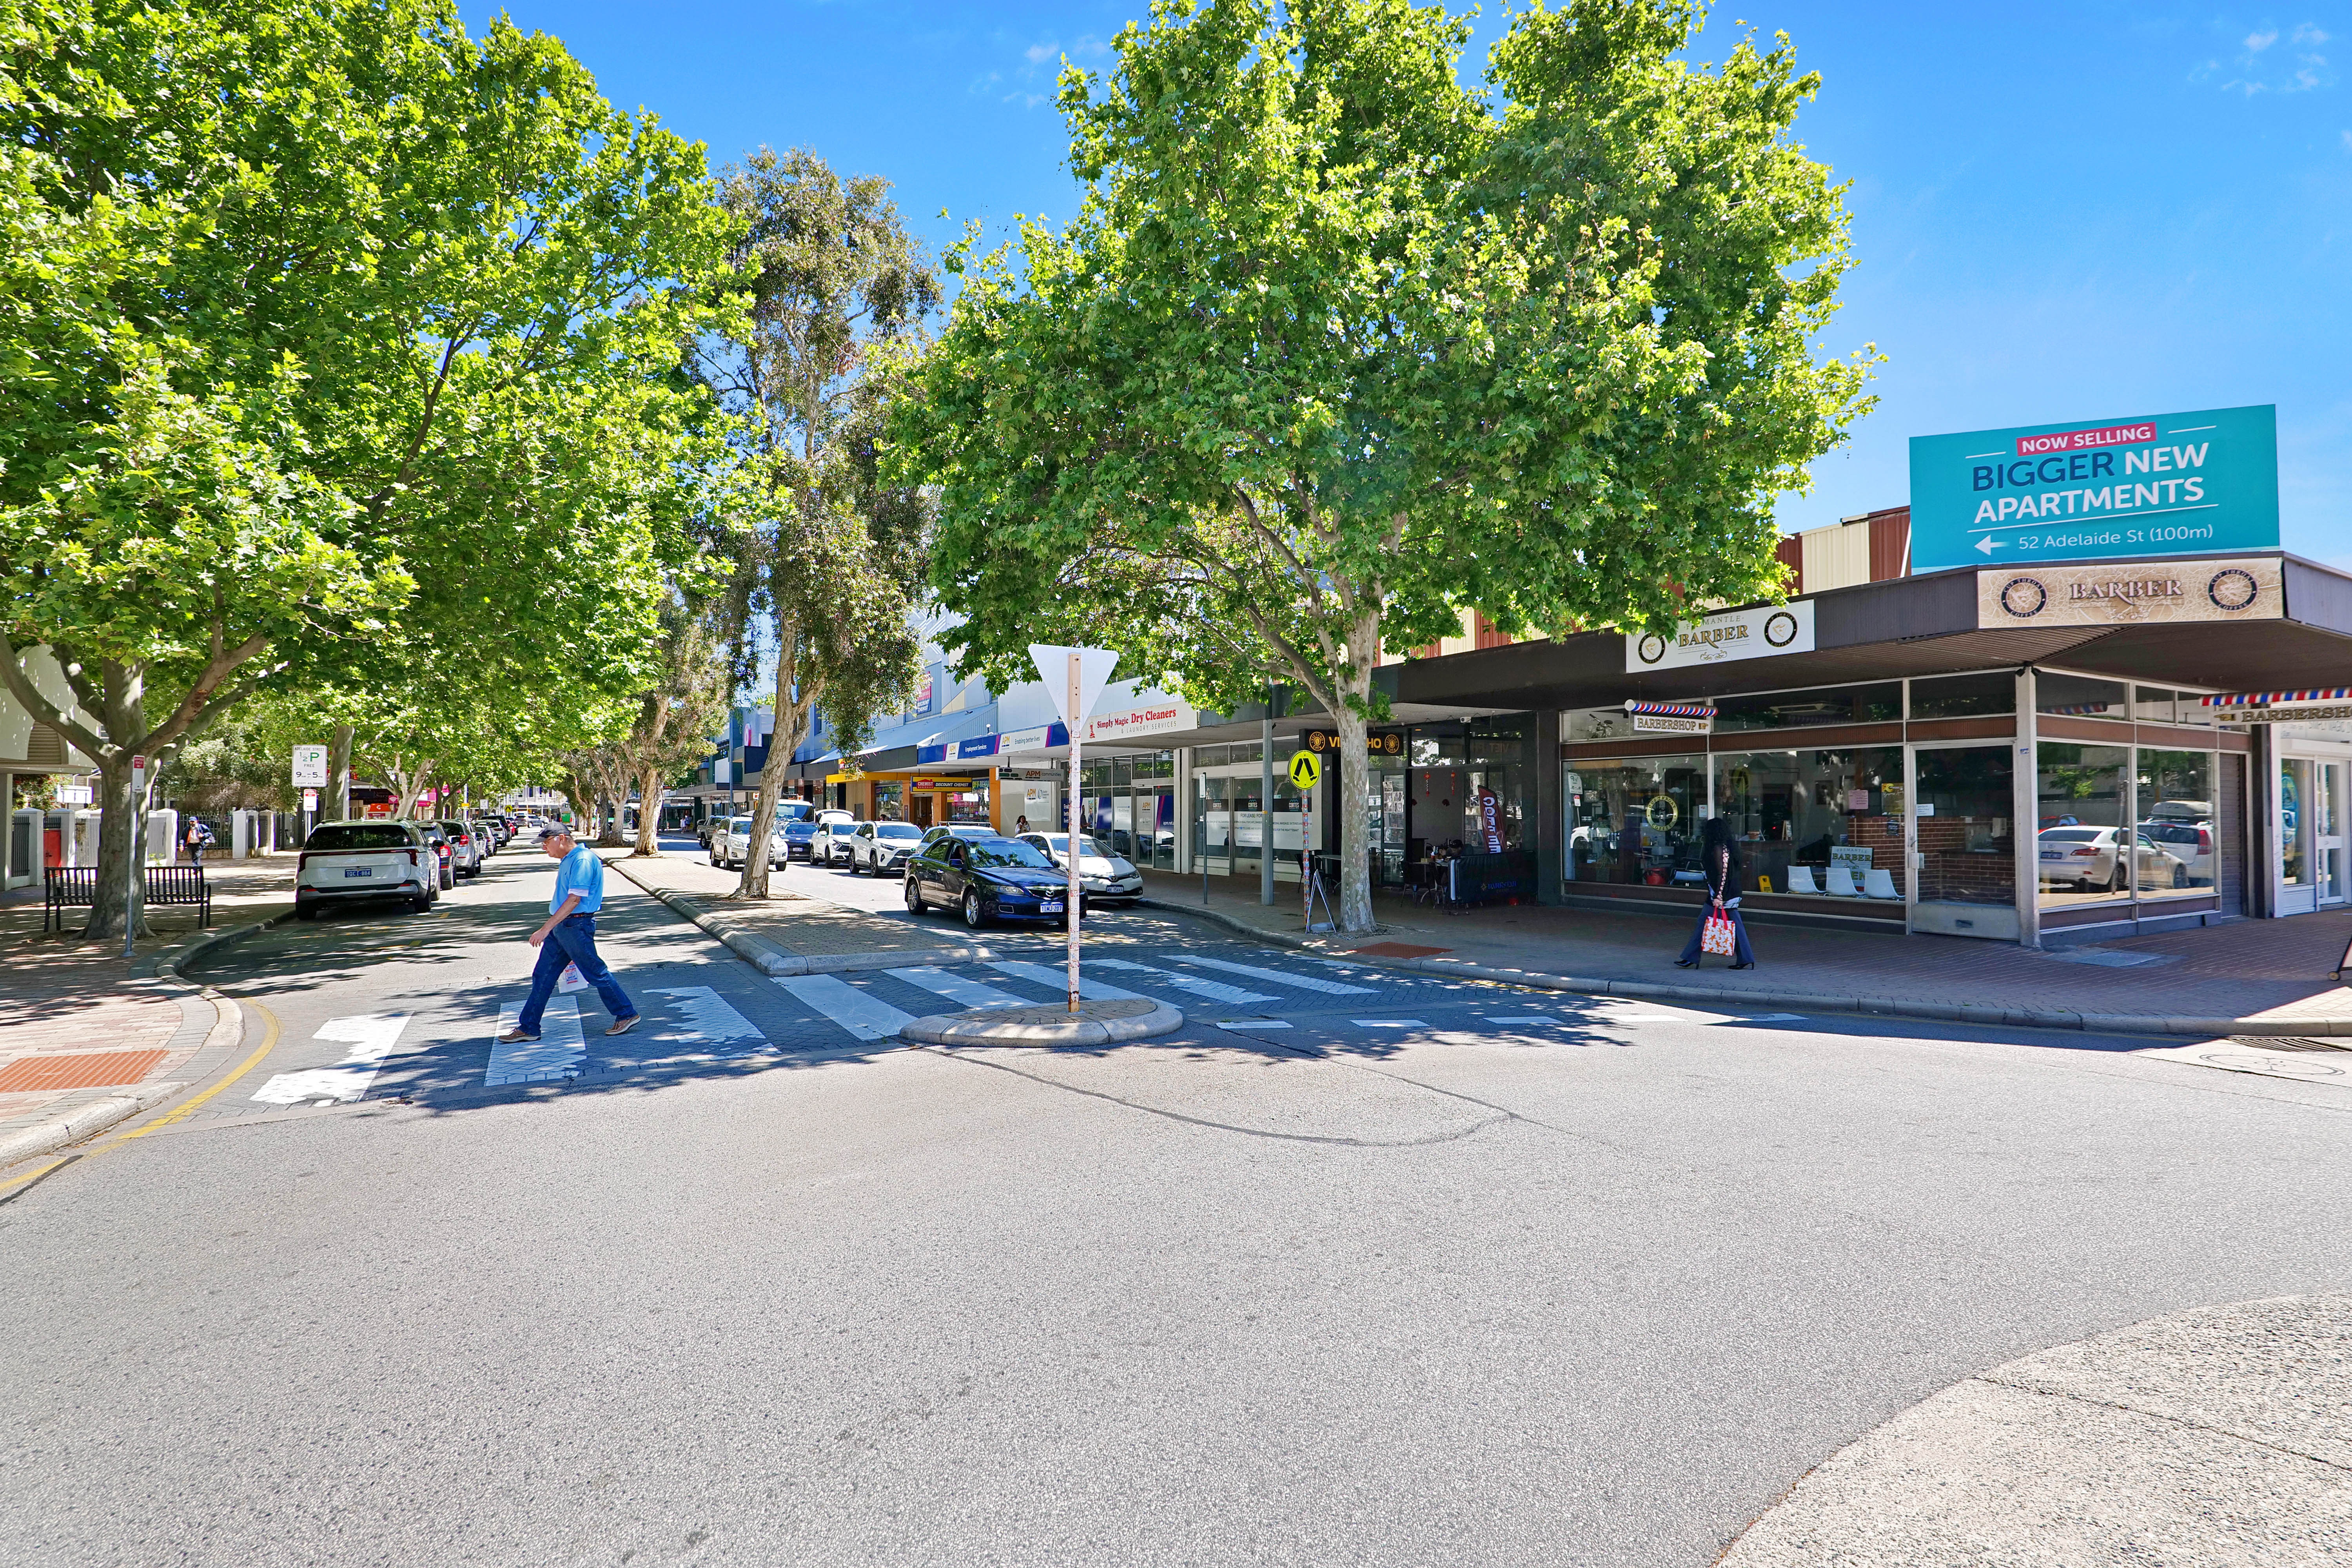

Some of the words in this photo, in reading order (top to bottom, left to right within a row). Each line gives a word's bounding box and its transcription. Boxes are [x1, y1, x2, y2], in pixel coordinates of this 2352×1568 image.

[2022, 436, 2069, 454] NOW
[2074, 426, 2151, 447] SELLING
[1973, 451, 2115, 492] BIGGER
[2125, 442, 2209, 475] NEW
[1974, 477, 2204, 524] APARTMENTS
[2018, 536, 2039, 550] 52
[2043, 531, 2121, 548] Adelaide
[2126, 529, 2144, 543] St
[2149, 524, 2214, 543] (100m)
[2211, 572, 2223, 584] CUP
[2226, 570, 2253, 583] THROAT
[2004, 581, 2014, 593] CUP
[2017, 578, 2043, 591] THROAT
[2070, 580, 2184, 606] BARBER
[2010, 610, 2038, 618] COFFEE
[2218, 603, 2248, 611] COFFEE
[1686, 615, 1741, 630] FMANTLE
[1776, 613, 1794, 622] THROAT
[1678, 625, 1749, 649] BARBER
[1097, 719, 1113, 729] Simply
[1114, 717, 1129, 726] Magic
[1131, 713, 1144, 724] Dry
[1145, 709, 1176, 720] Cleaners
[2241, 706, 2352, 722] BARBERSH
[1127, 725, 1149, 733] LAUNDRY
[1152, 720, 1176, 730] SERVICES
[1637, 717, 1697, 731] BARBERSHOP
[1002, 735, 1010, 744] APM
[1310, 733, 1324, 742] VIETPHO
[1328, 737, 1341, 747] VI
[1367, 738, 1382, 748] HO
[1027, 788, 1036, 797] APM
[1658, 796, 1676, 808] THROAT
[1483, 797, 1501, 854] COFFEE
[1831, 853, 1872, 864] BARBER
[1851, 871, 1866, 880] EN
